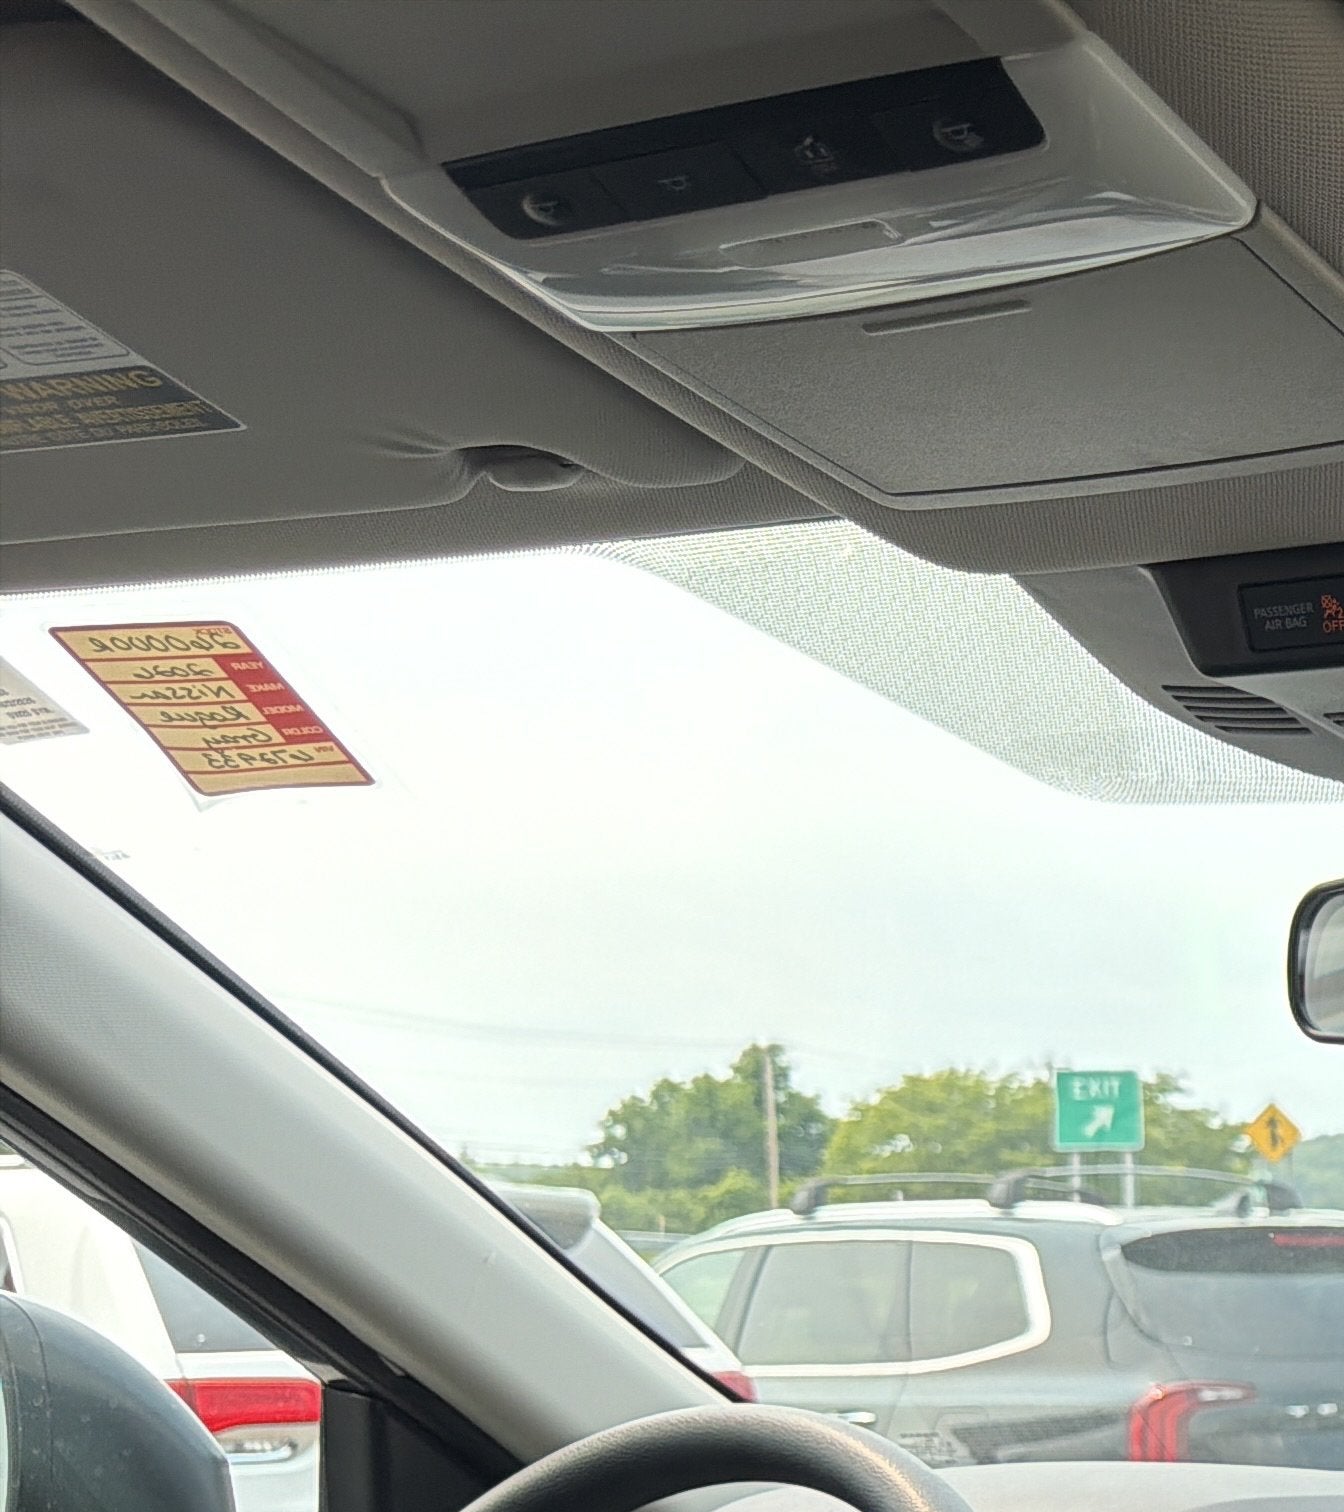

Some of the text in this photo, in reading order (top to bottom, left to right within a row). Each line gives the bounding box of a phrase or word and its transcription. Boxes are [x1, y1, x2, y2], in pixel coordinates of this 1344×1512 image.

[1253, 602, 1315, 619] PASSENGER
[1264, 616, 1308, 632] AIR BAG
[1072, 1076, 1121, 1101] EXIT
